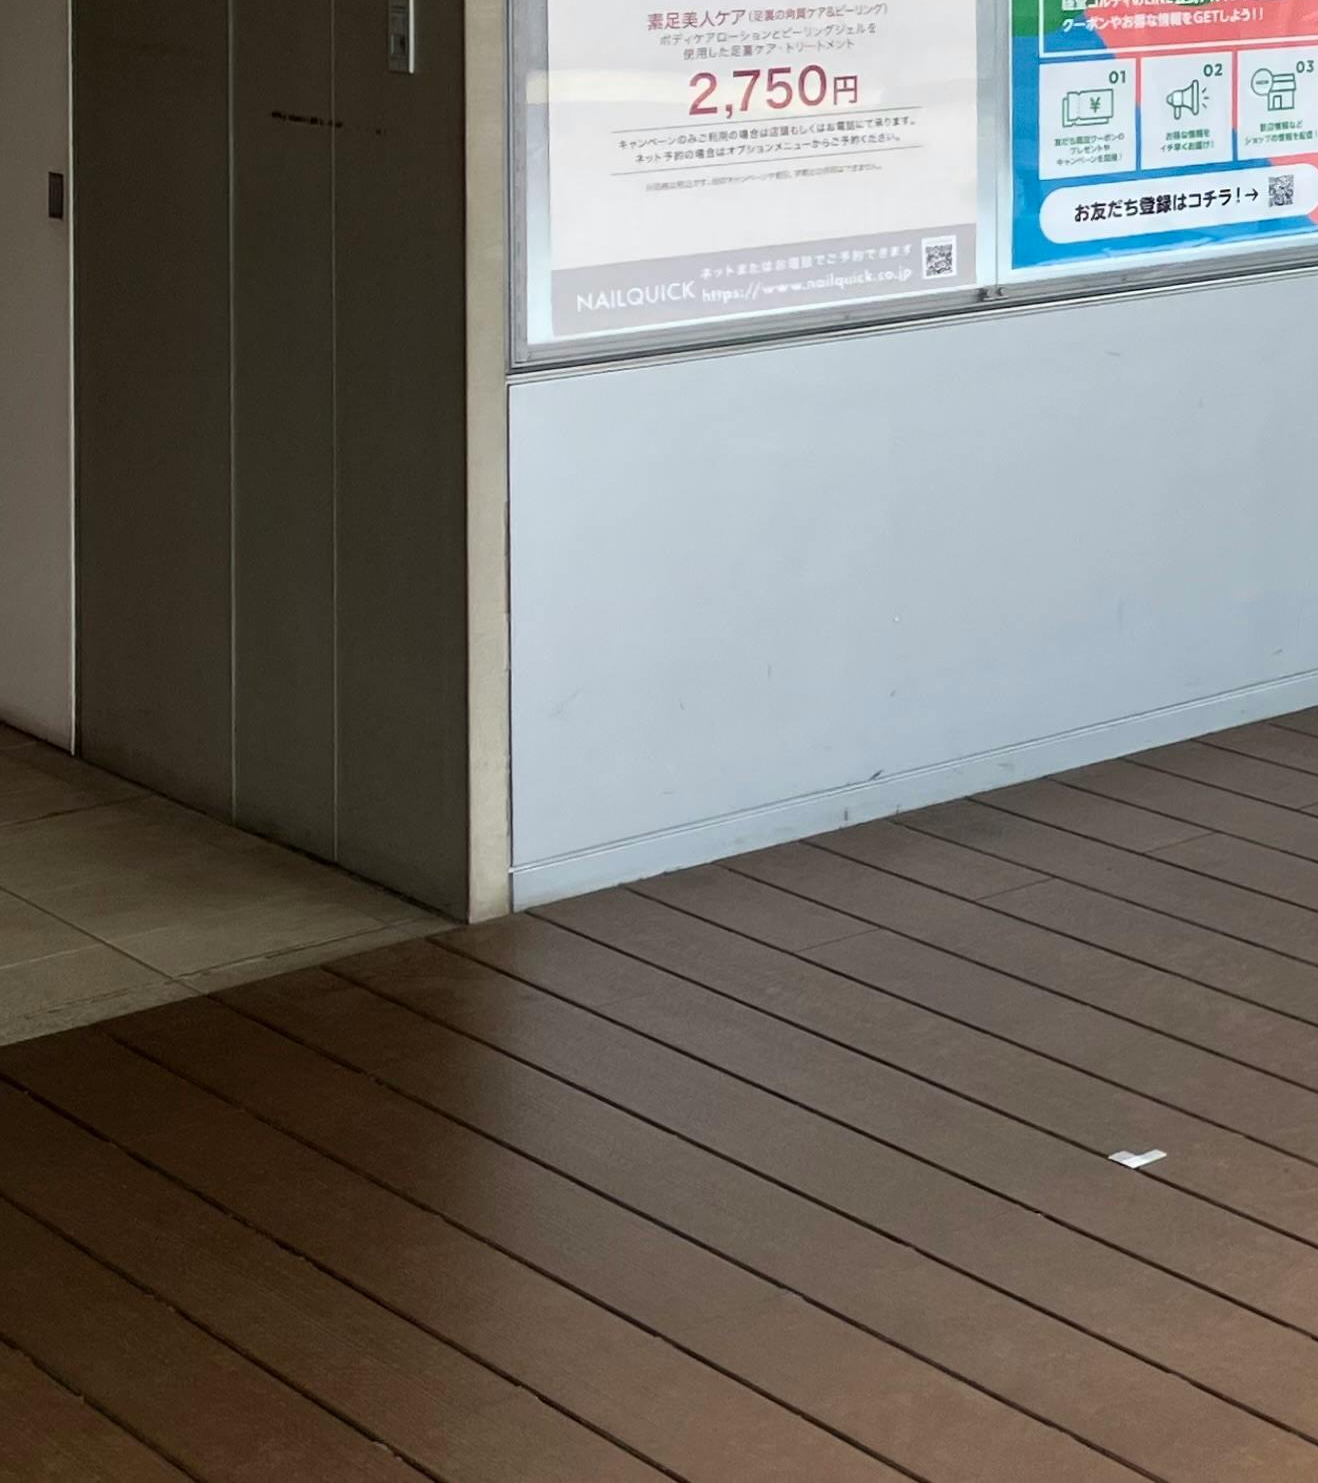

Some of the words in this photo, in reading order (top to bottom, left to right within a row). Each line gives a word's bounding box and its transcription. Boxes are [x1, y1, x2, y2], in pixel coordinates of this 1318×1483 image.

[1203, 63, 1223, 78] 02
[1296, 59, 1315, 74] 03
[1108, 70, 1127, 85] 01
[688, 64, 859, 119] 2,750円
[576, 279, 698, 314] NAILQUICK
